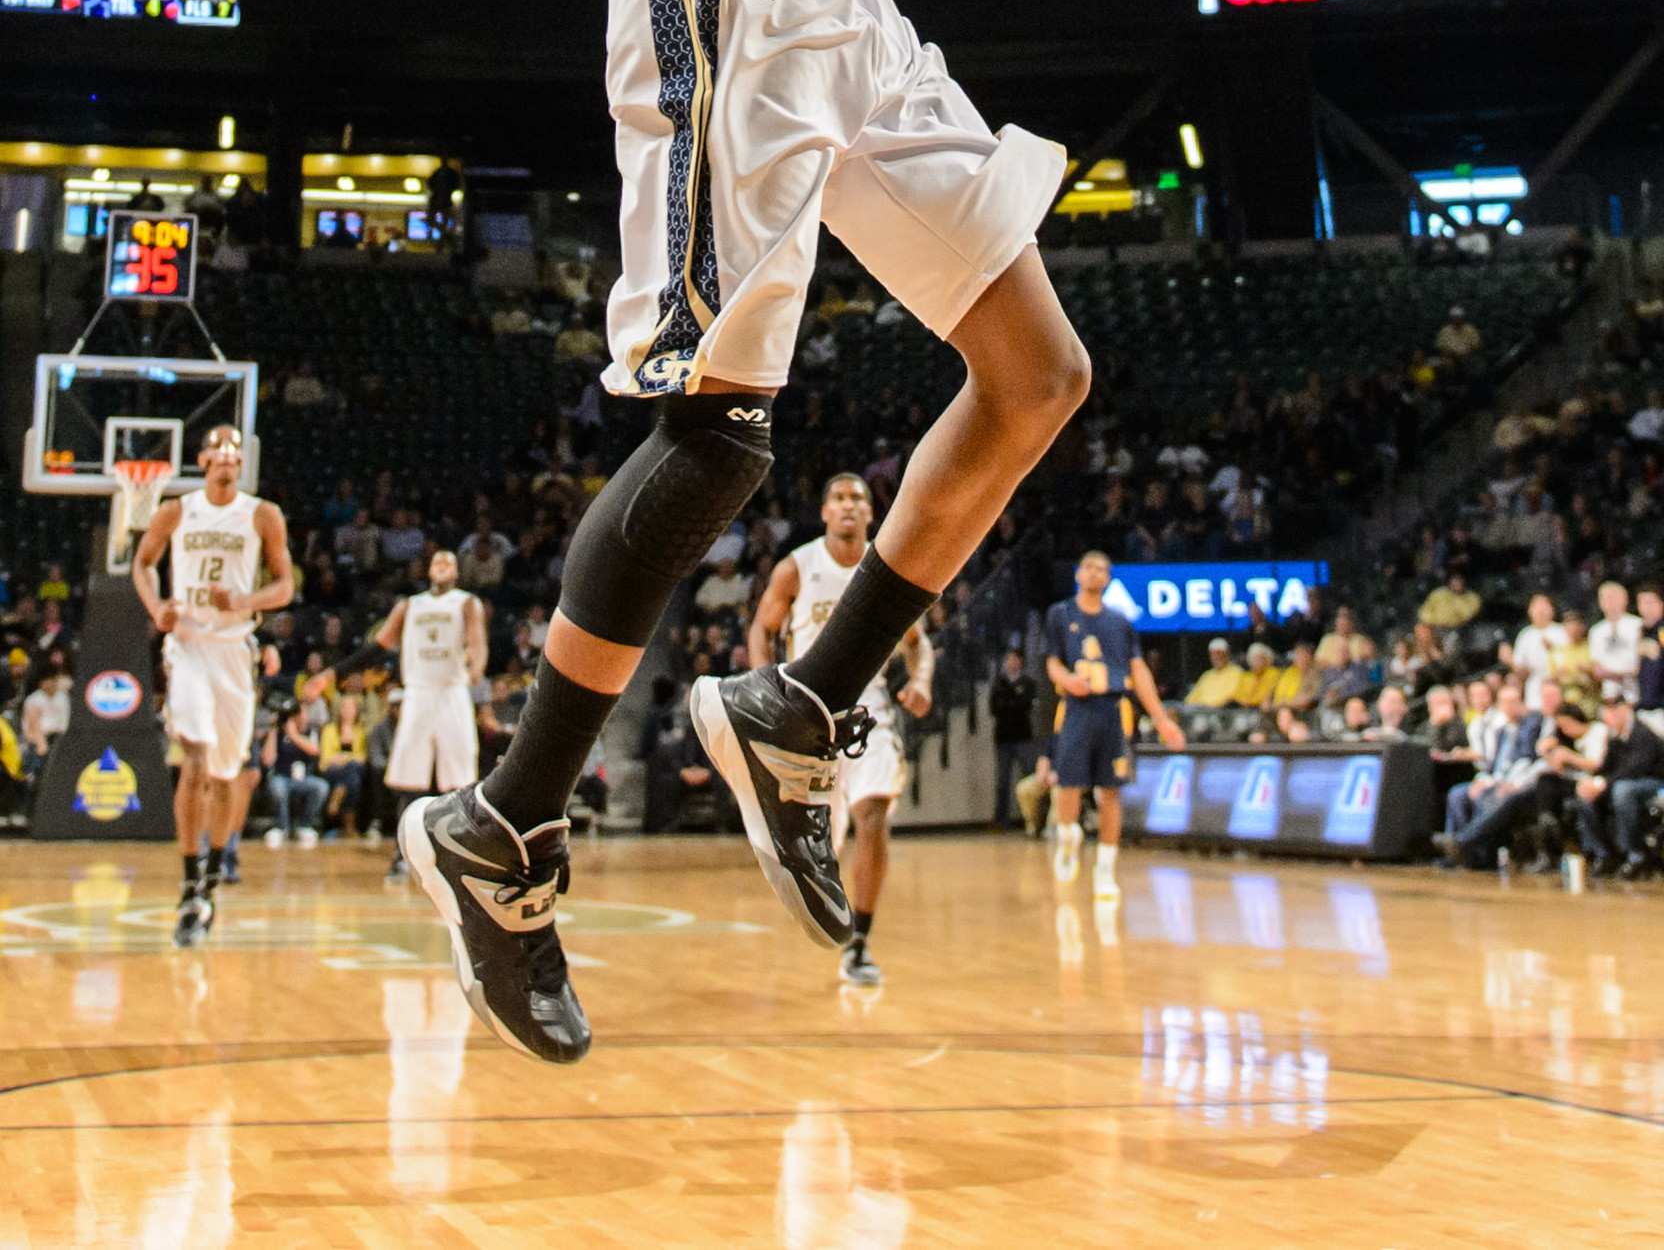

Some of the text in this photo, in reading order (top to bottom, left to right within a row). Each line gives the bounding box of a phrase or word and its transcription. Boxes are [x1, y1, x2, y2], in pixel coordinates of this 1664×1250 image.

[126, 245, 178, 294] 35
[184, 530, 245, 552] GEORGIA
[198, 557, 224, 582] 12
[1147, 577, 1310, 618] DELTA
